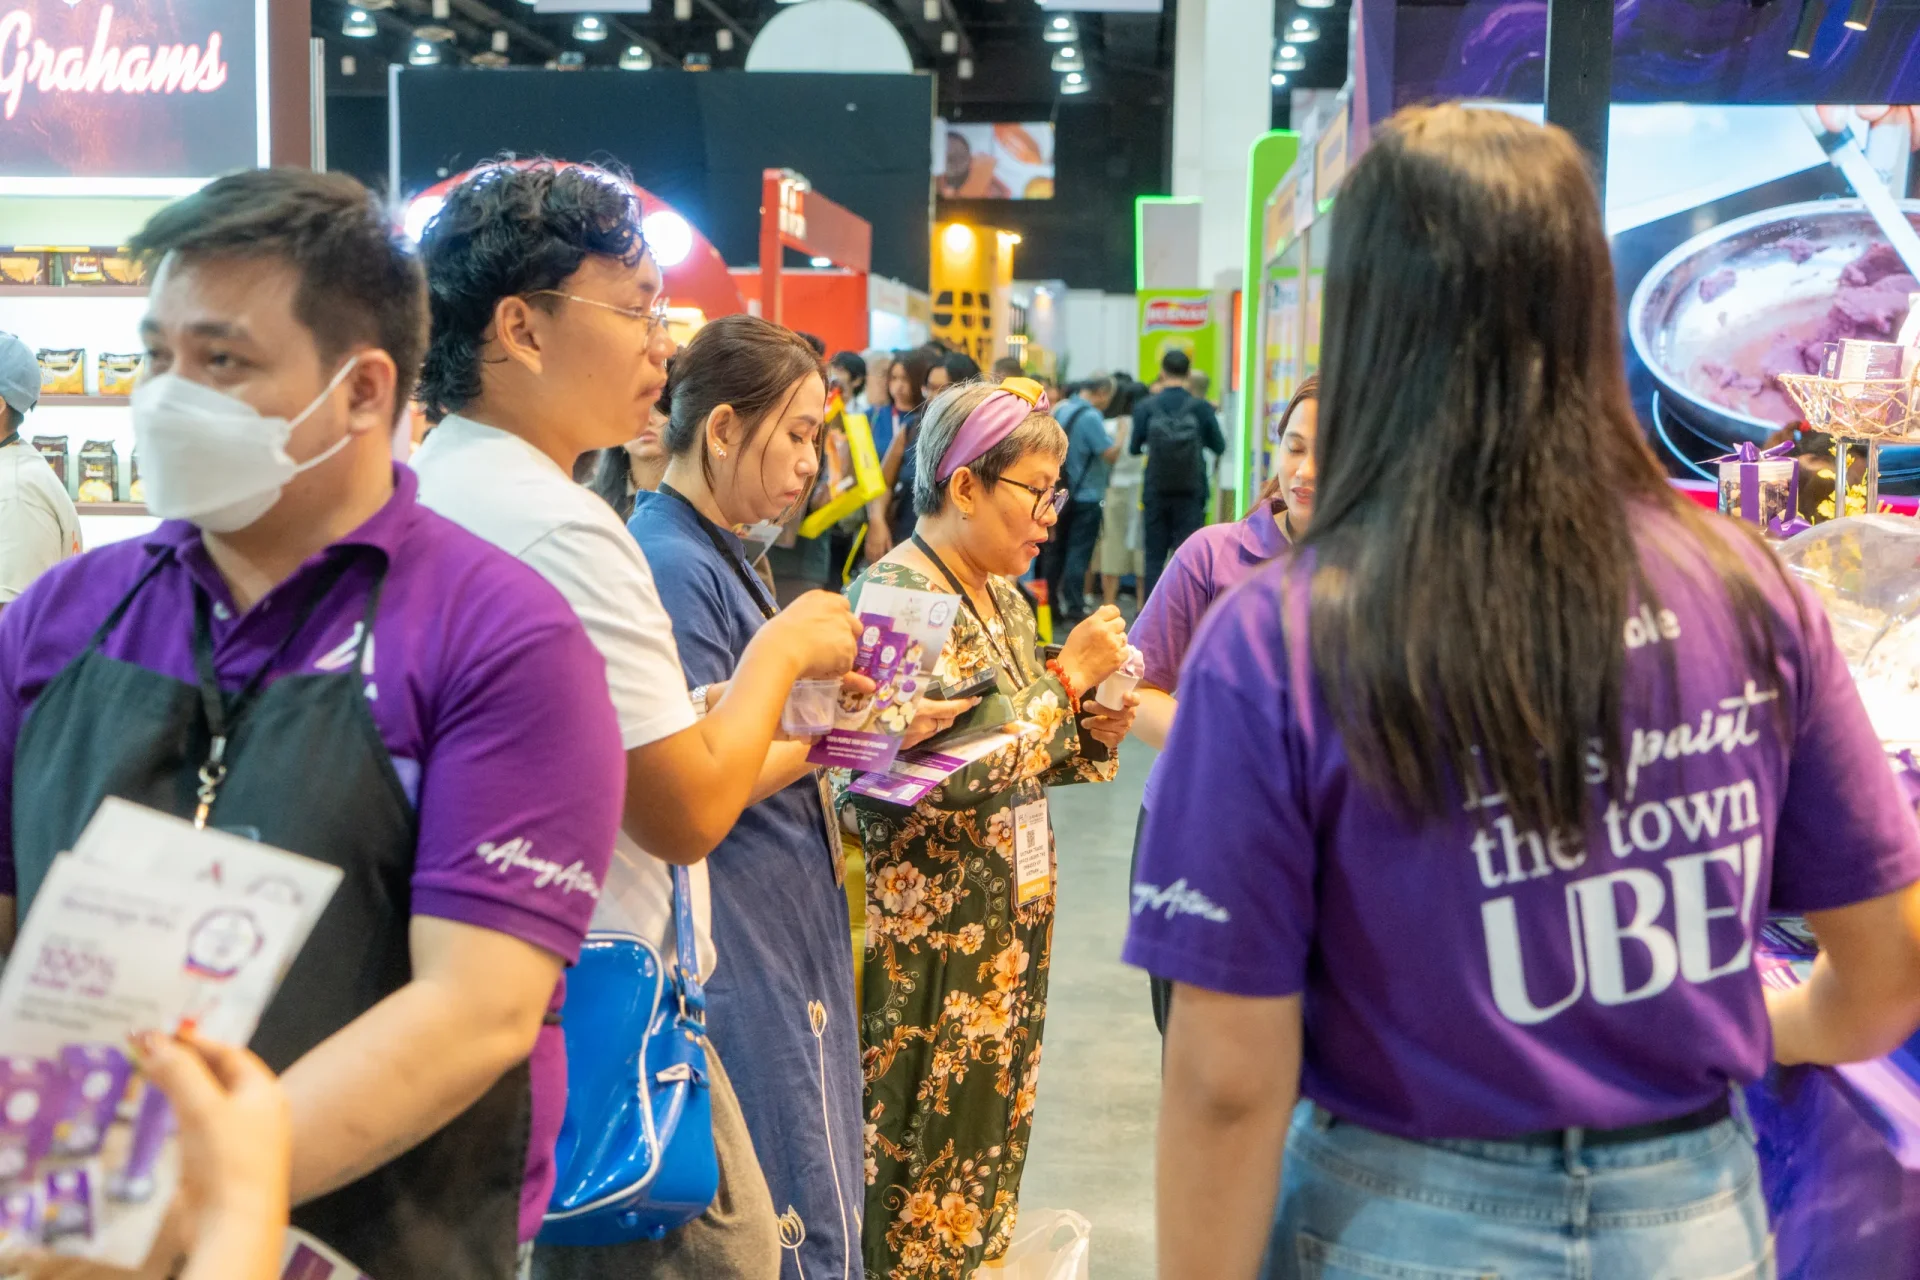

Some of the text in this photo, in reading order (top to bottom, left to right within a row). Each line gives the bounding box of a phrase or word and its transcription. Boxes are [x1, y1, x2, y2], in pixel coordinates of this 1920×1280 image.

[0, 4, 228, 120] Grahams
[1625, 680, 1778, 801] paint
[1470, 778, 1761, 889] the town
